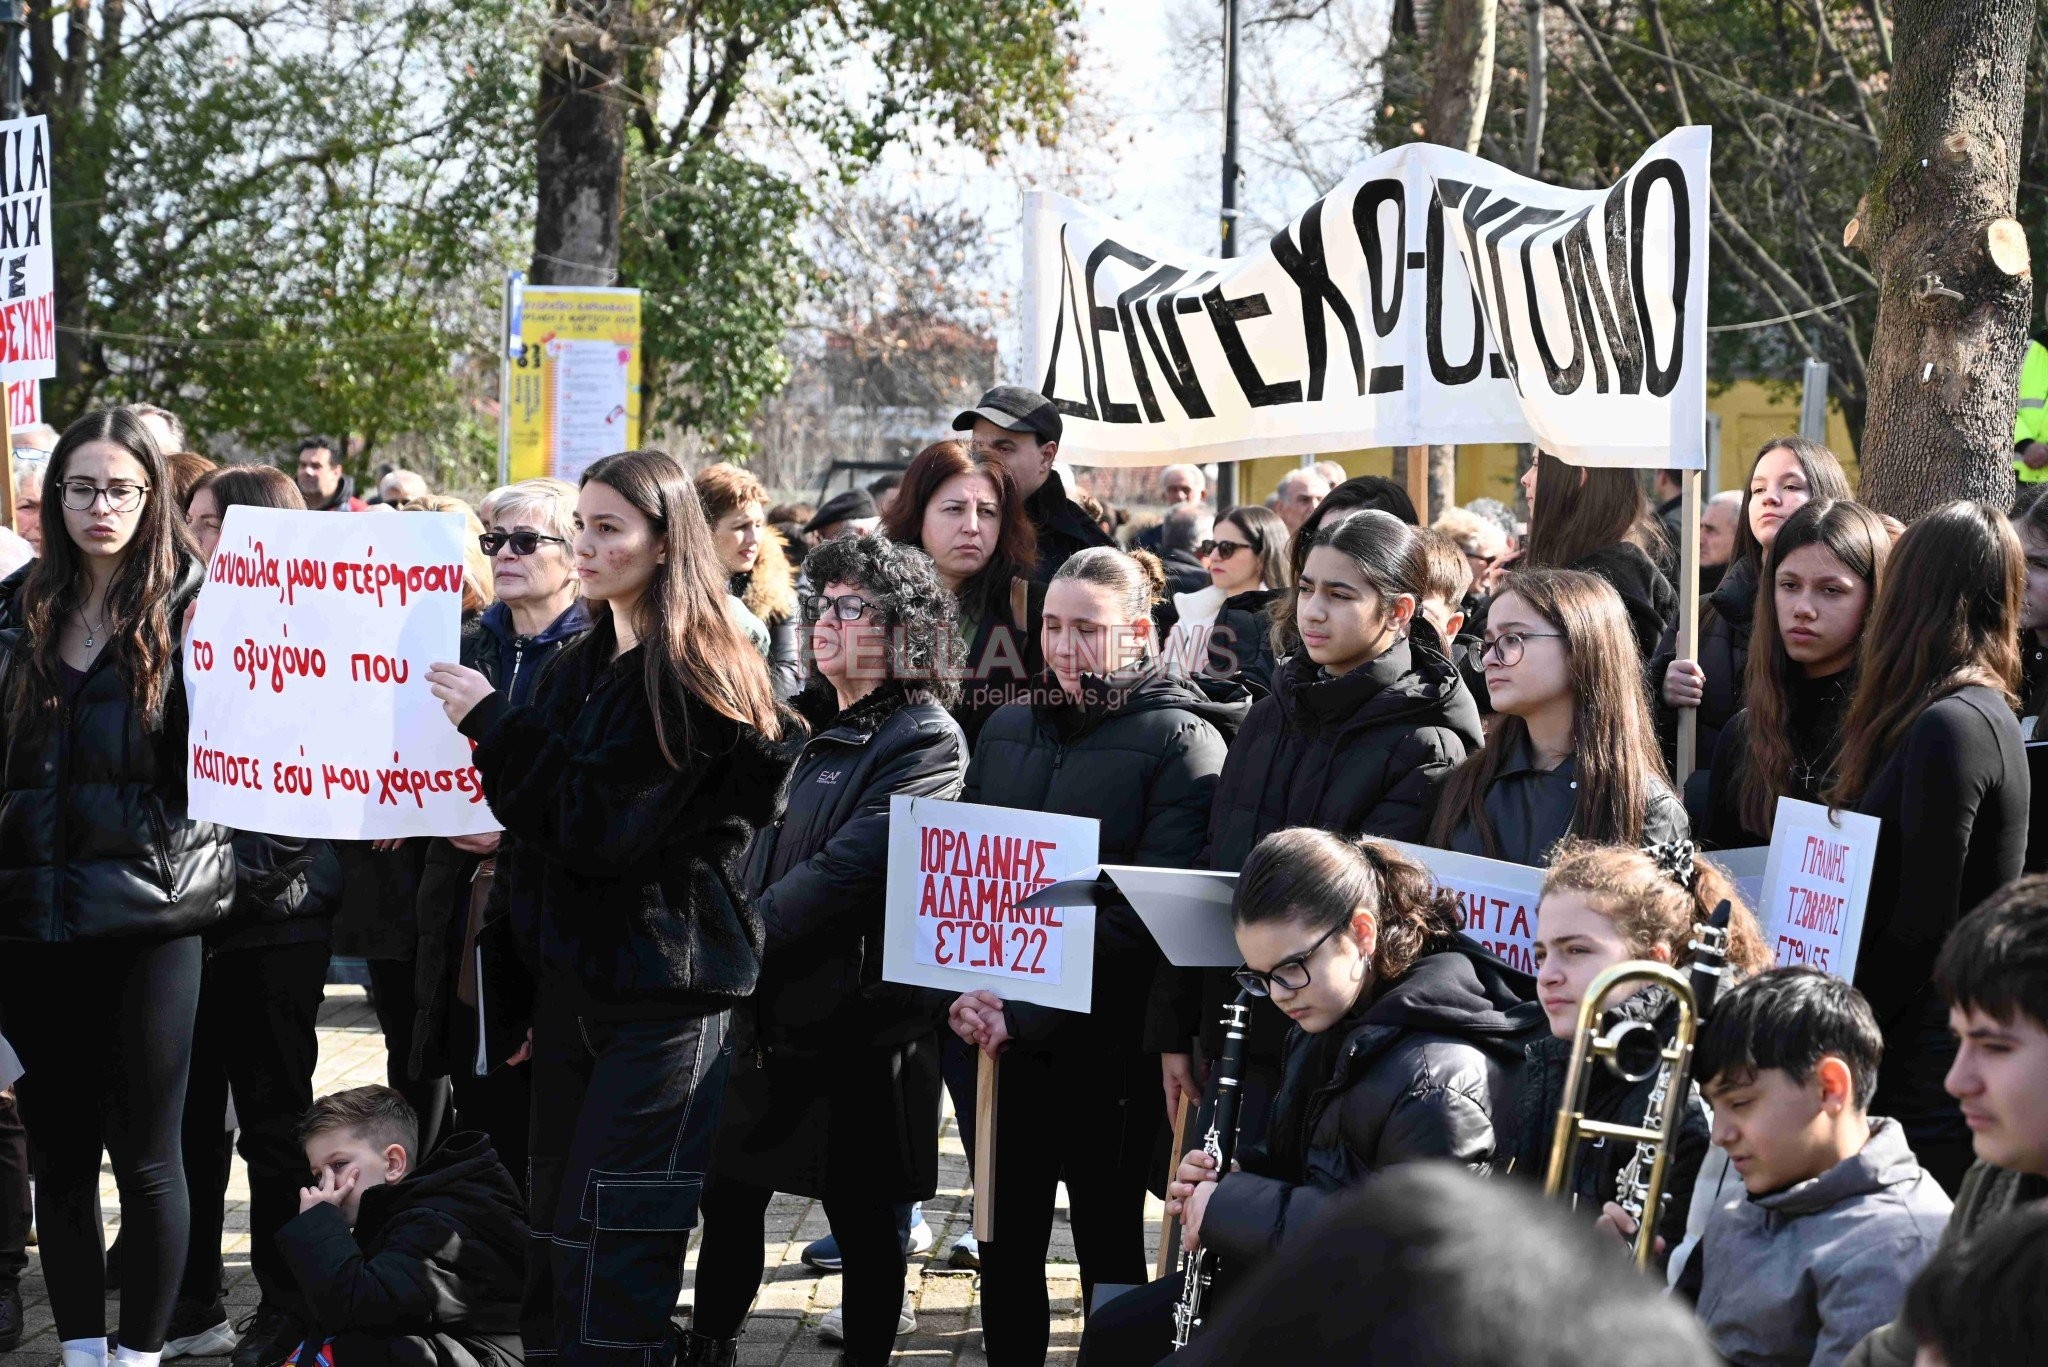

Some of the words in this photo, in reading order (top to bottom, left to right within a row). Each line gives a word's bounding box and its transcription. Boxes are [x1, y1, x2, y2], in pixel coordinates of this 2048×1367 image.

[286, 558, 327, 606] μου
[332, 545, 464, 607] στέρησαν
[192, 640, 214, 671] το
[233, 623, 326, 693] οξυγόνο
[351, 653, 409, 684] που
[193, 729, 263, 790] κάποτε
[273, 744, 312, 796] εσύ
[322, 763, 370, 800] μου
[376, 751, 484, 809] χάρισες
[920, 826, 1057, 884] ΙΟΡΔΑΝΗΣ
